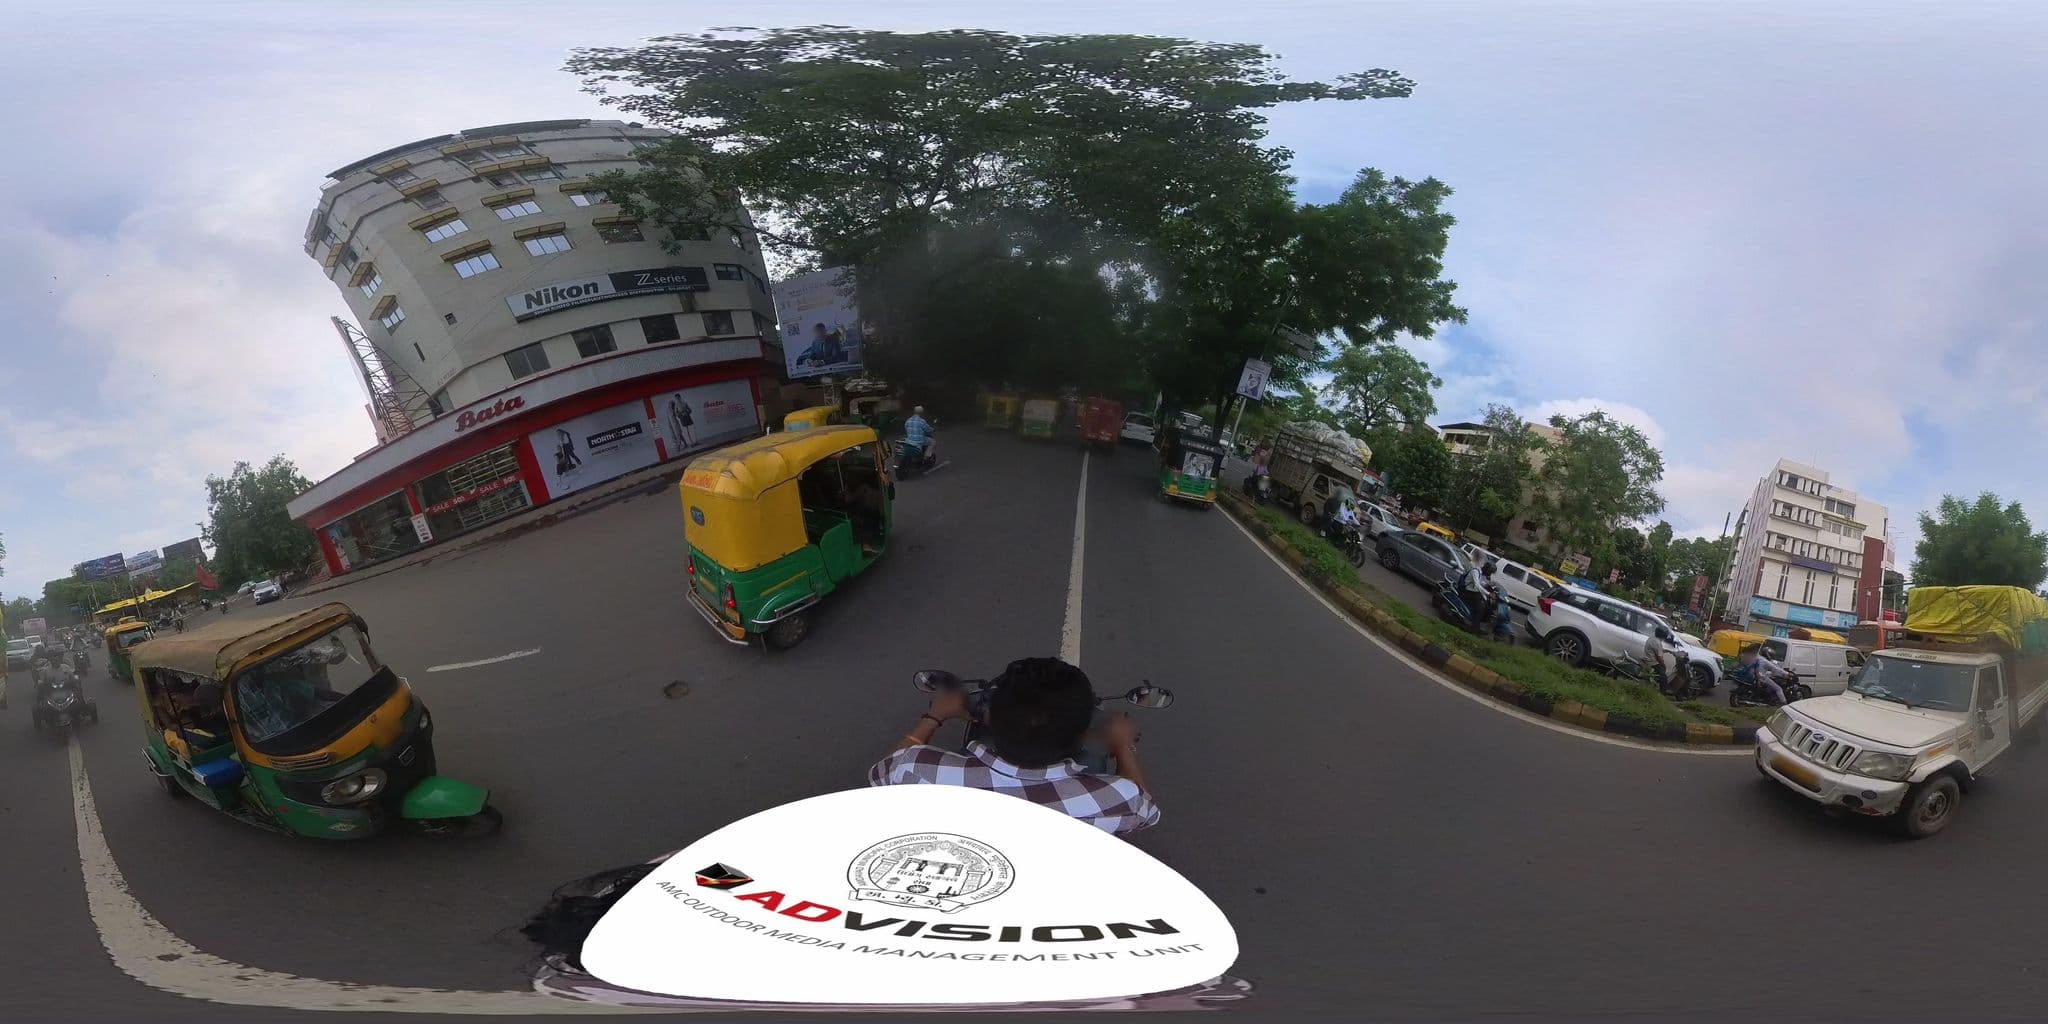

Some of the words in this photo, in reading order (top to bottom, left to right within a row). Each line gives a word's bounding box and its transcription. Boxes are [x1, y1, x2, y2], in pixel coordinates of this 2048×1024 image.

[653, 274, 688, 284] series
[523, 281, 599, 310] Nikon
[455, 395, 525, 432] Bata
[591, 433, 615, 445] NORTH
[620, 426, 637, 436] STAR
[433, 502, 450, 513] SALE
[480, 482, 499, 494] SALE
